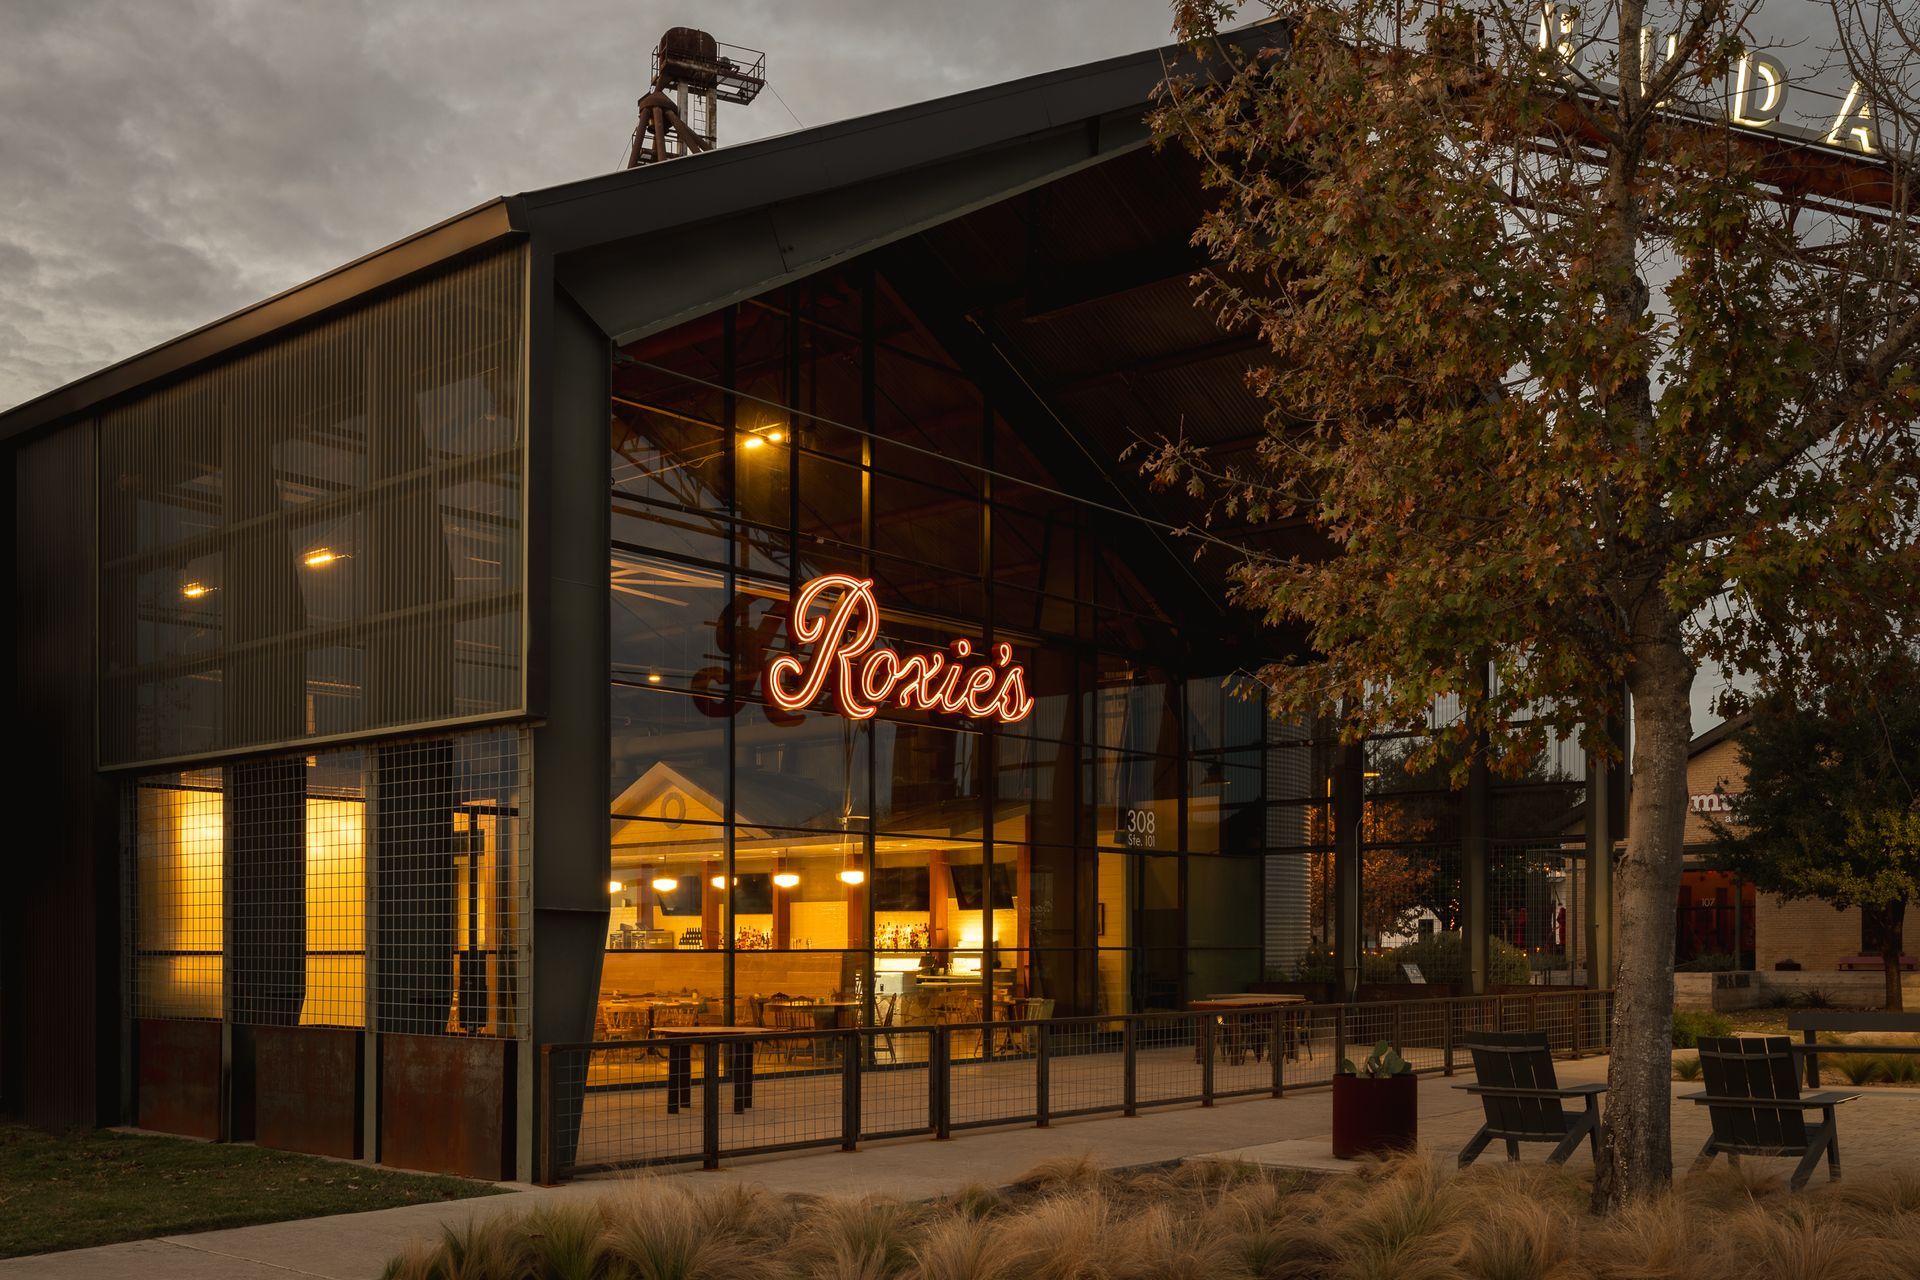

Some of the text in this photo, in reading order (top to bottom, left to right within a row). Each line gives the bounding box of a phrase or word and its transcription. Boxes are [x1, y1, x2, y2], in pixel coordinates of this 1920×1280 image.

[768, 573, 1035, 724] Roxie's
[1127, 809, 1156, 834] 308
[1128, 834, 1156, 848] Ste. 101
